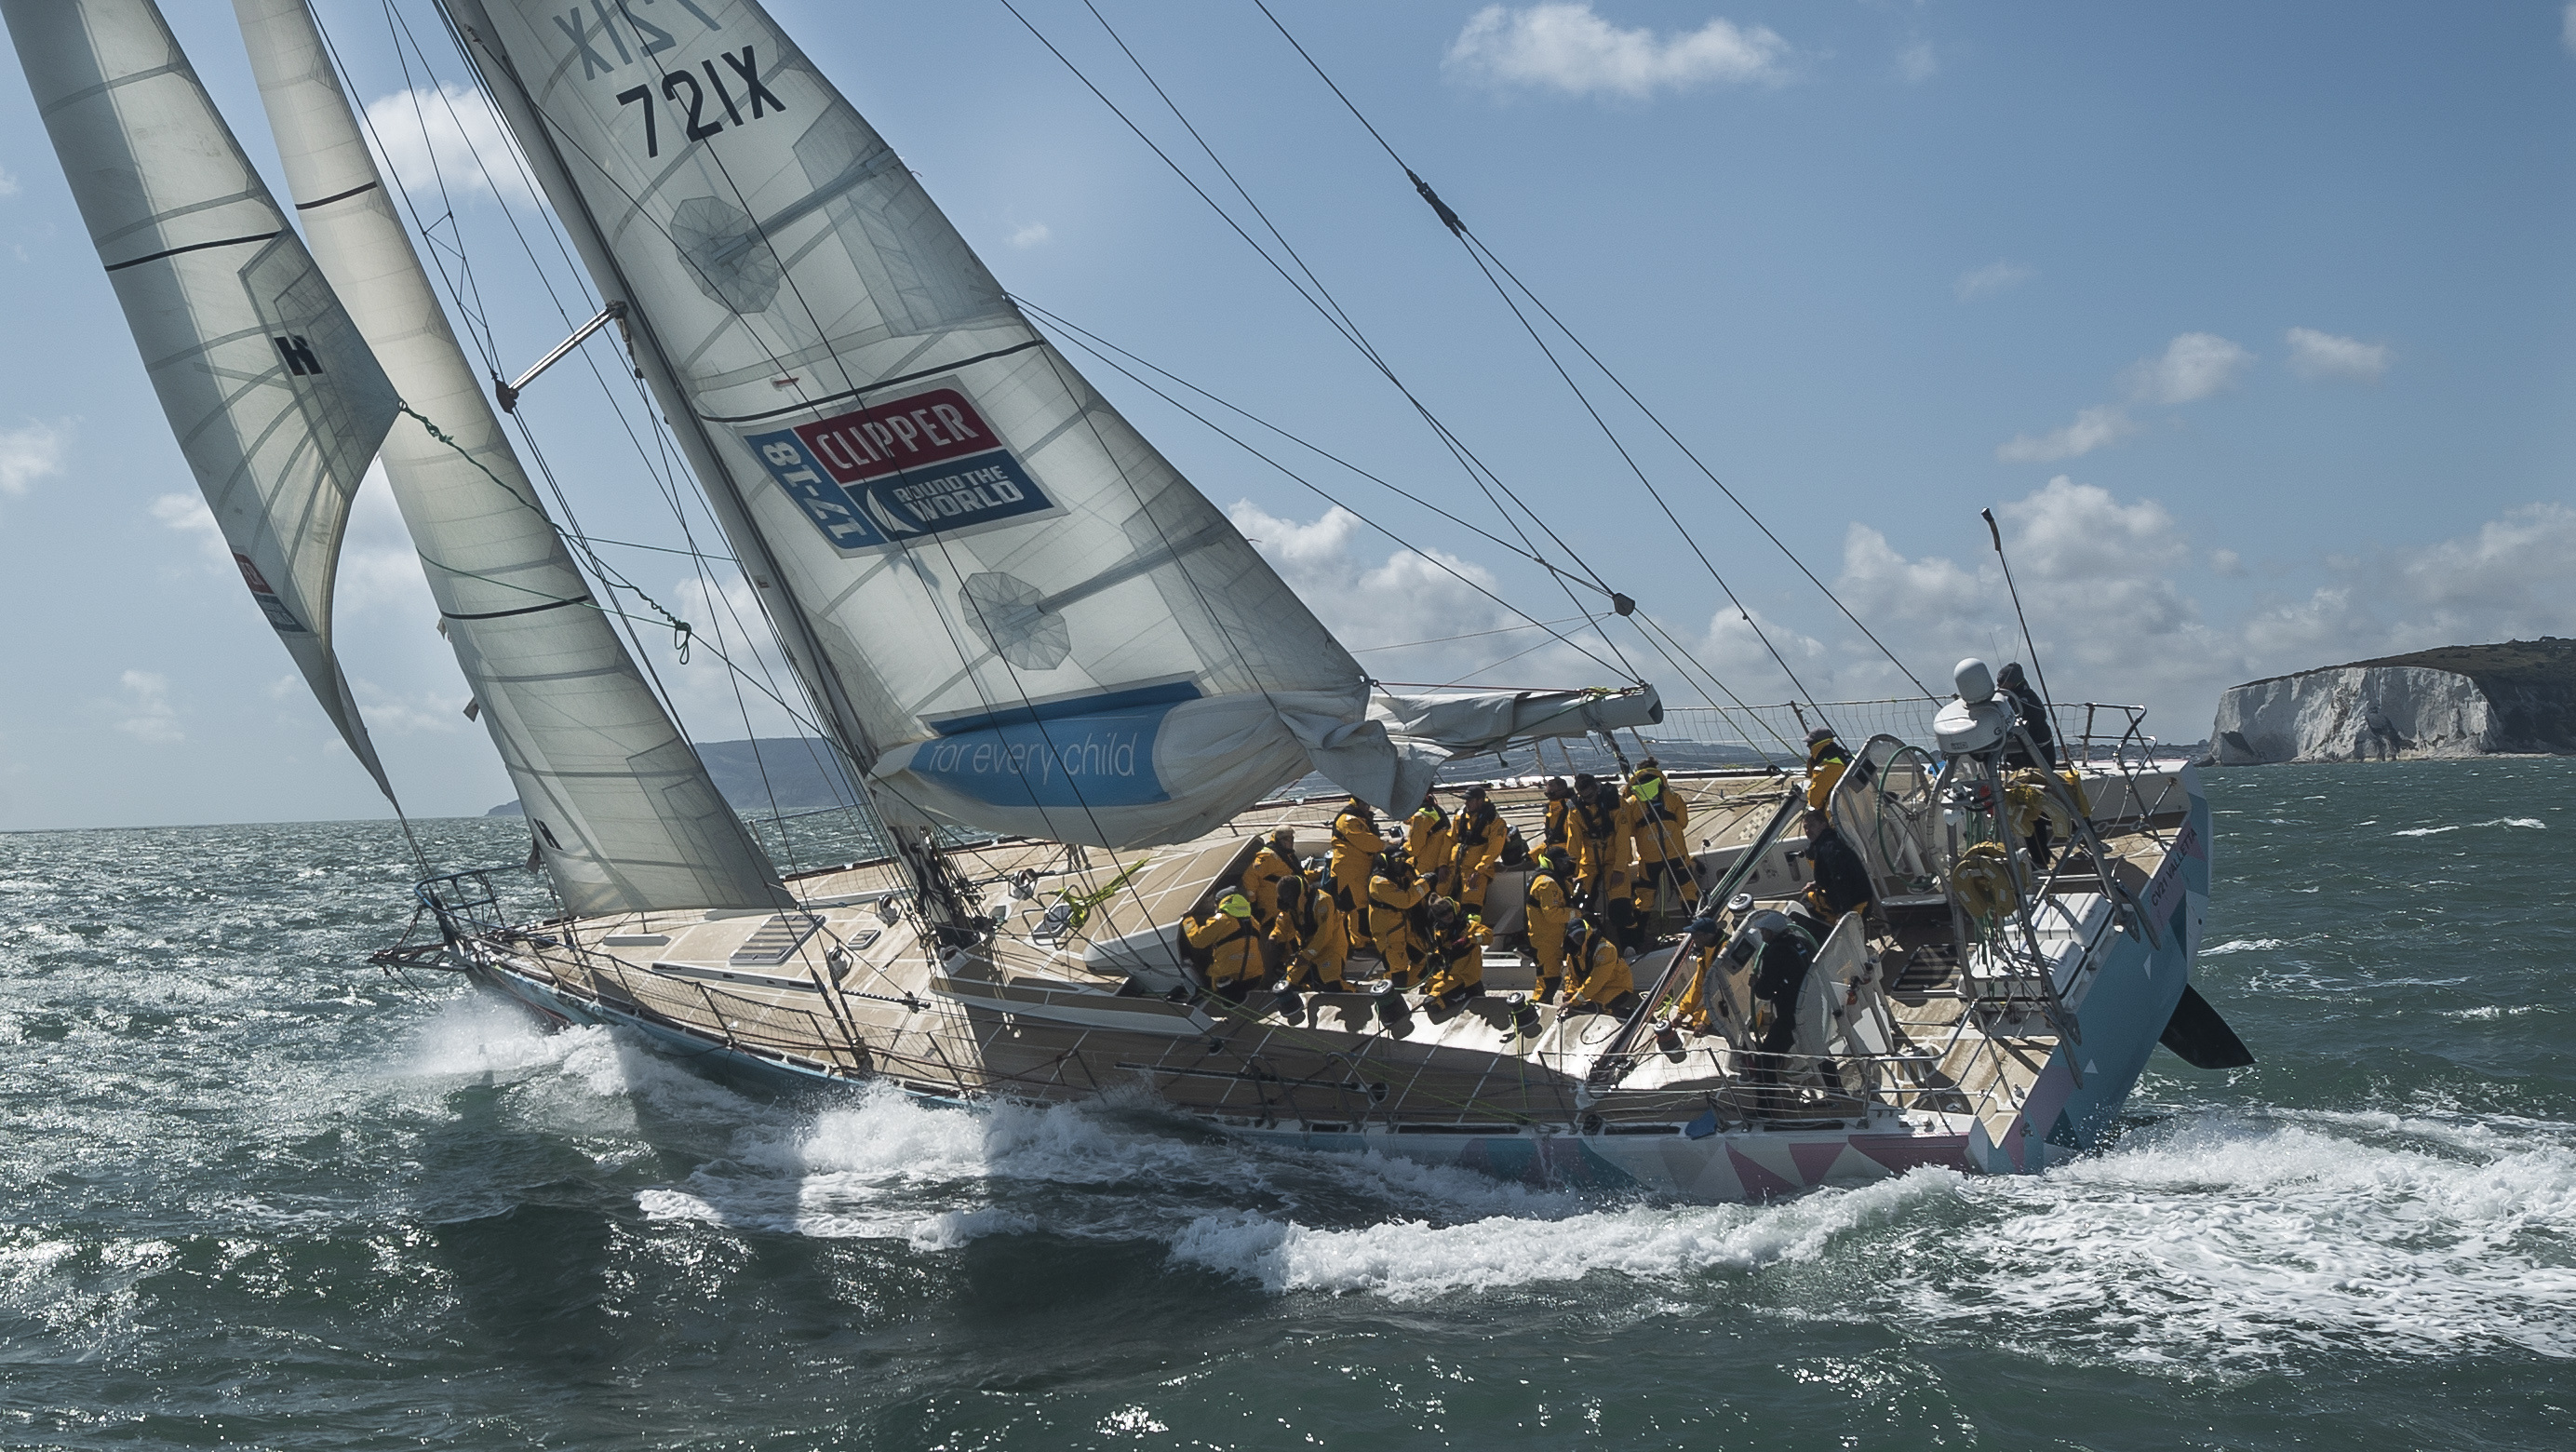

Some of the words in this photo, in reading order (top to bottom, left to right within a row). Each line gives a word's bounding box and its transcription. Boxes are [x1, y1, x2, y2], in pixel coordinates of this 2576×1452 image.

[616, 45, 785, 158] 721X
[817, 403, 980, 469] CLIPPER
[762, 440, 867, 540] 17-18
[893, 473, 967, 503] ROUND
[964, 464, 1009, 491] THE
[903, 480, 1025, 522] WORLD
[928, 738, 972, 773] for
[973, 742, 1057, 786] every
[1063, 733, 1138, 776] child
[2151, 878, 2169, 908] CV21
[2166, 827, 2198, 881] VALLETTA
